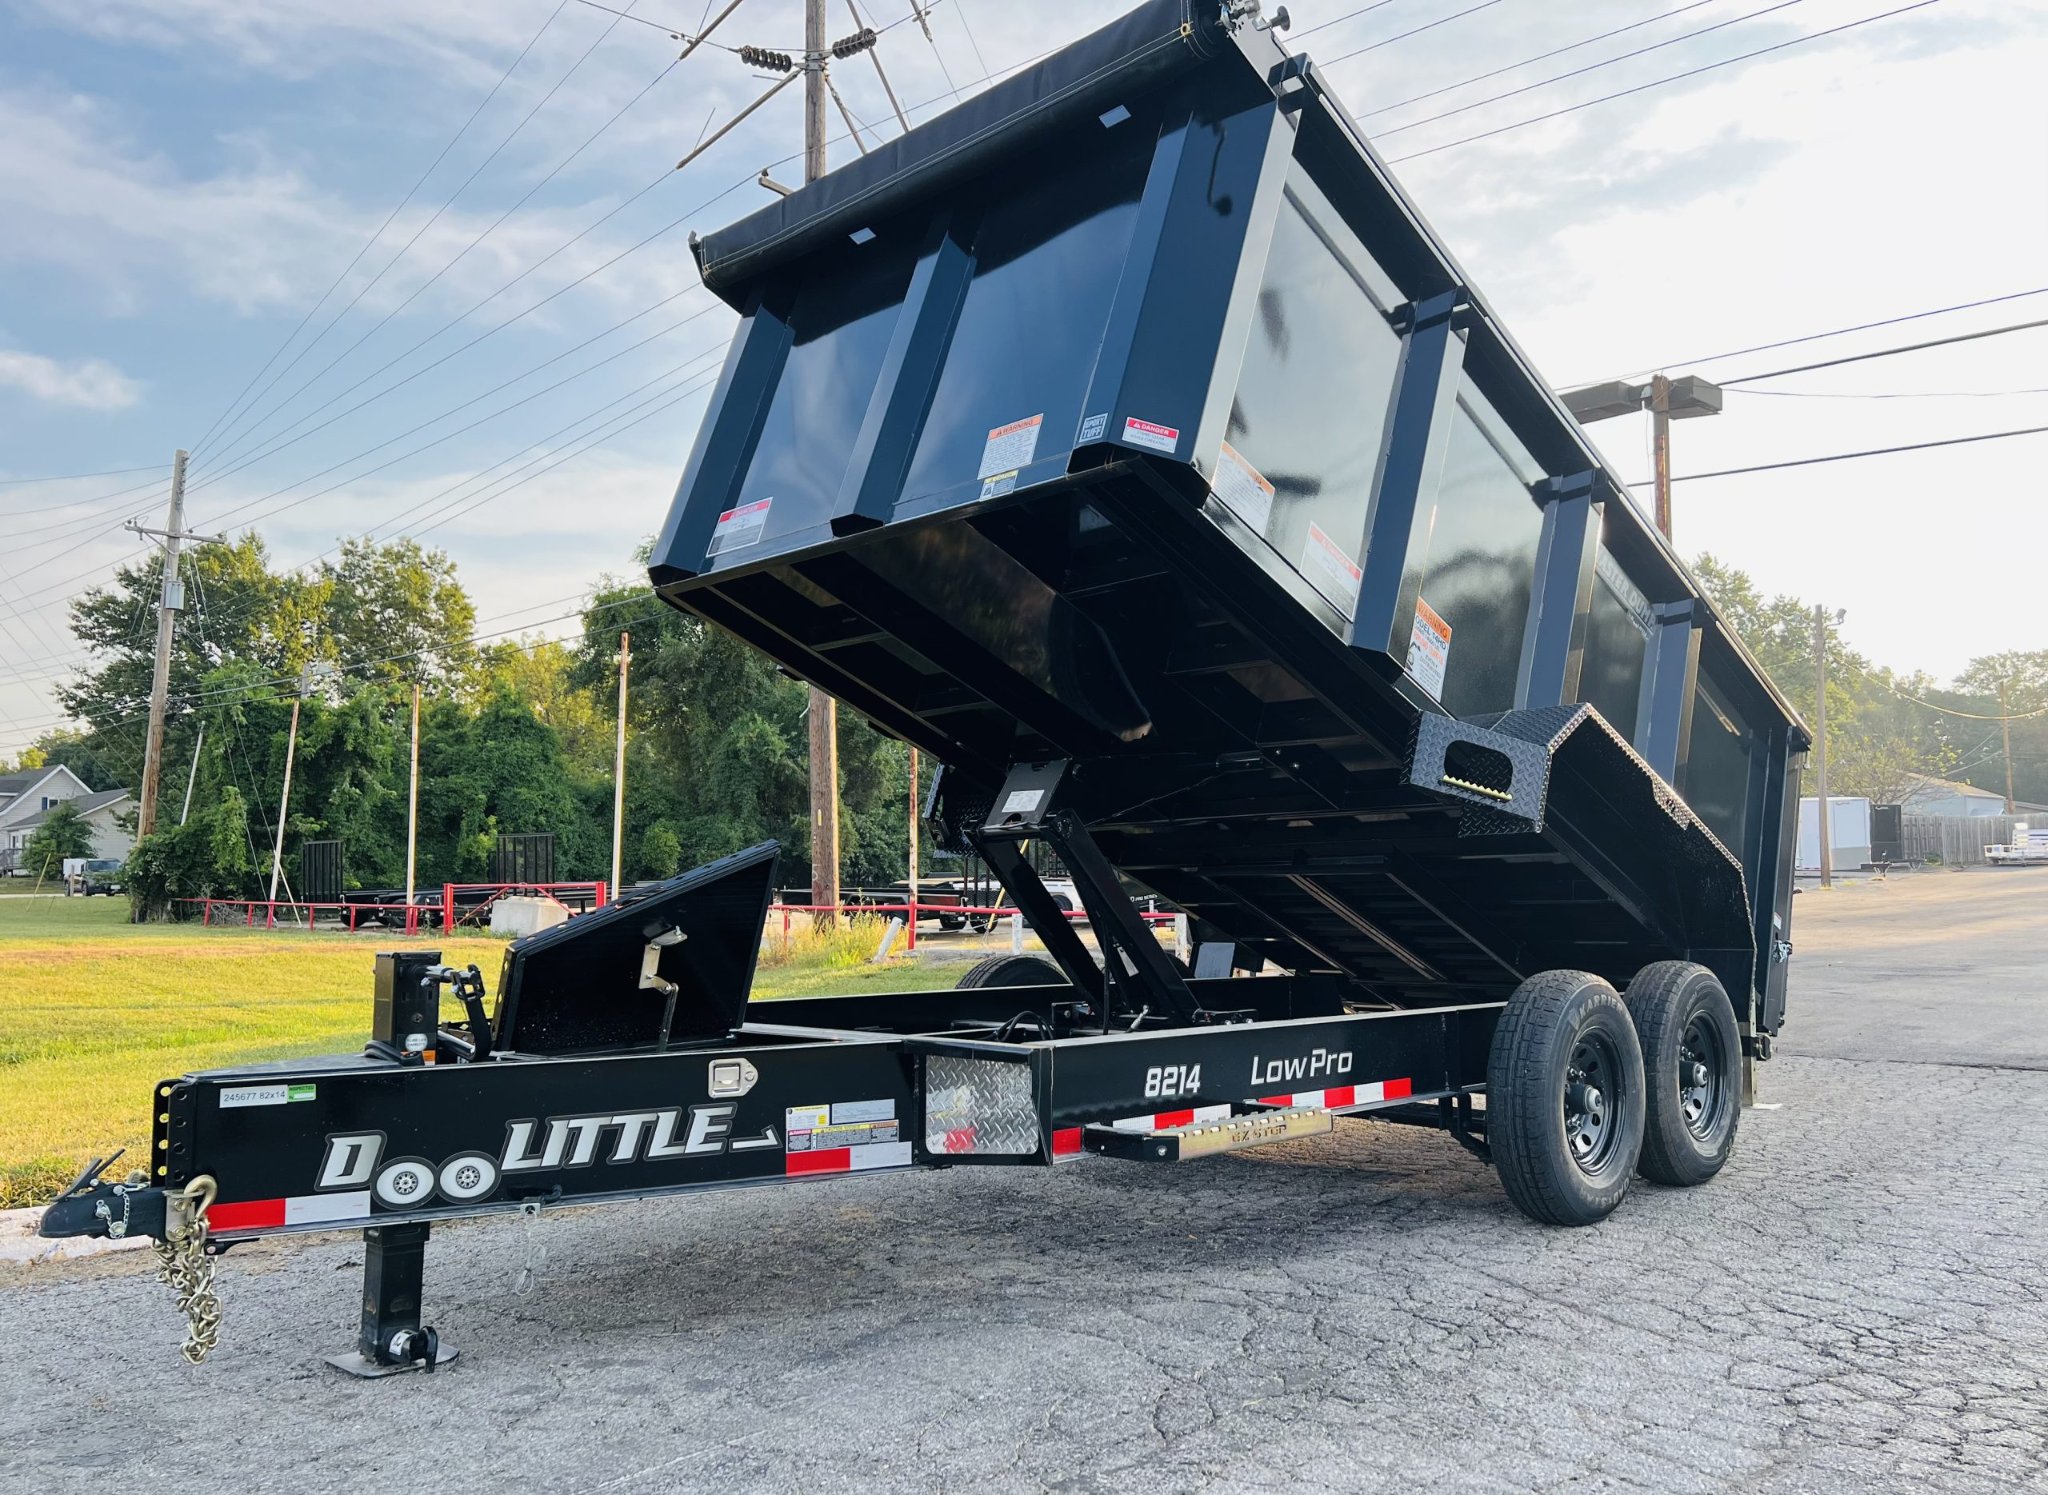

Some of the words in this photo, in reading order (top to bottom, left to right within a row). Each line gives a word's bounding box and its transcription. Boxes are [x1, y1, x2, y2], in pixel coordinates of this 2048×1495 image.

[1003, 419, 1033, 434] WARNING
[1085, 416, 1104, 428] EPOXY
[1141, 425, 1169, 435] DANGER
[1083, 426, 1101, 438] TUFF
[1415, 616, 1430, 633] ODEL
[1418, 602, 1447, 638] WARNING
[1580, 994, 1622, 1019] KARRIER
[1251, 1048, 1352, 1086] LowPro
[1145, 1064, 1200, 1097] 8214
[224, 1093, 256, 1102] 245677
[259, 1091, 285, 1100] 82x14
